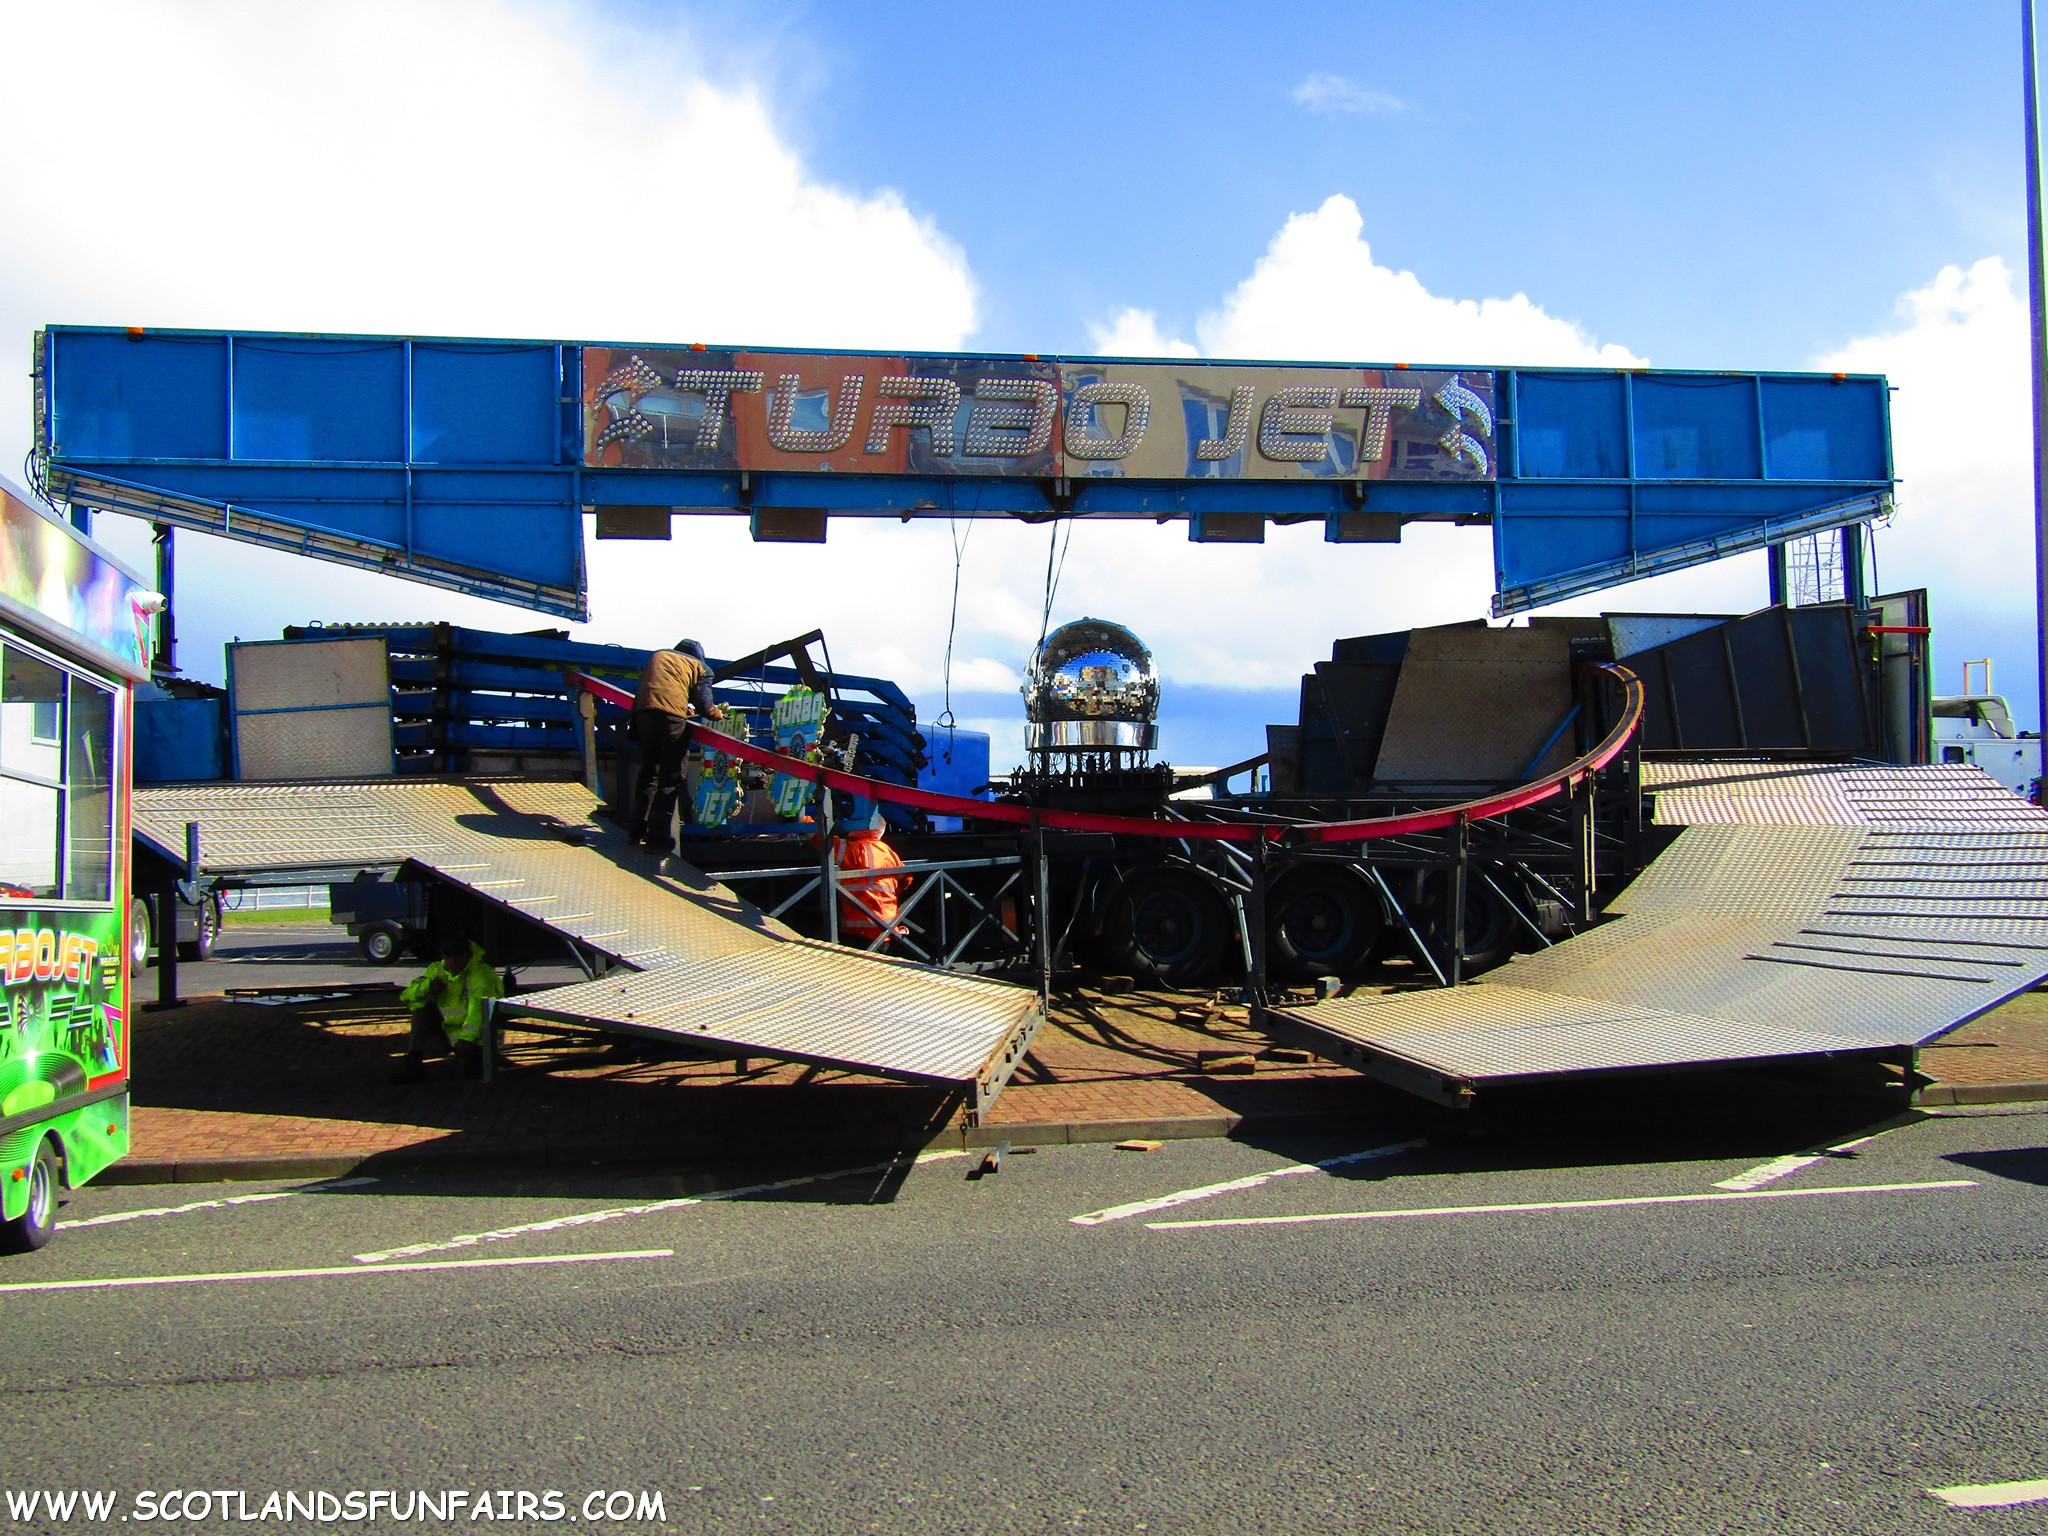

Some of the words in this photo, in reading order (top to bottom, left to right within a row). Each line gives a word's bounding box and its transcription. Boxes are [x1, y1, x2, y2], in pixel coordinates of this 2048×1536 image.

[674, 369, 1151, 460] TURBO
[1197, 384, 1421, 462] JET
[702, 713, 744, 738] RBO
[775, 692, 824, 727] TURBO
[698, 792, 731, 824] JET
[775, 779, 809, 814] JET
